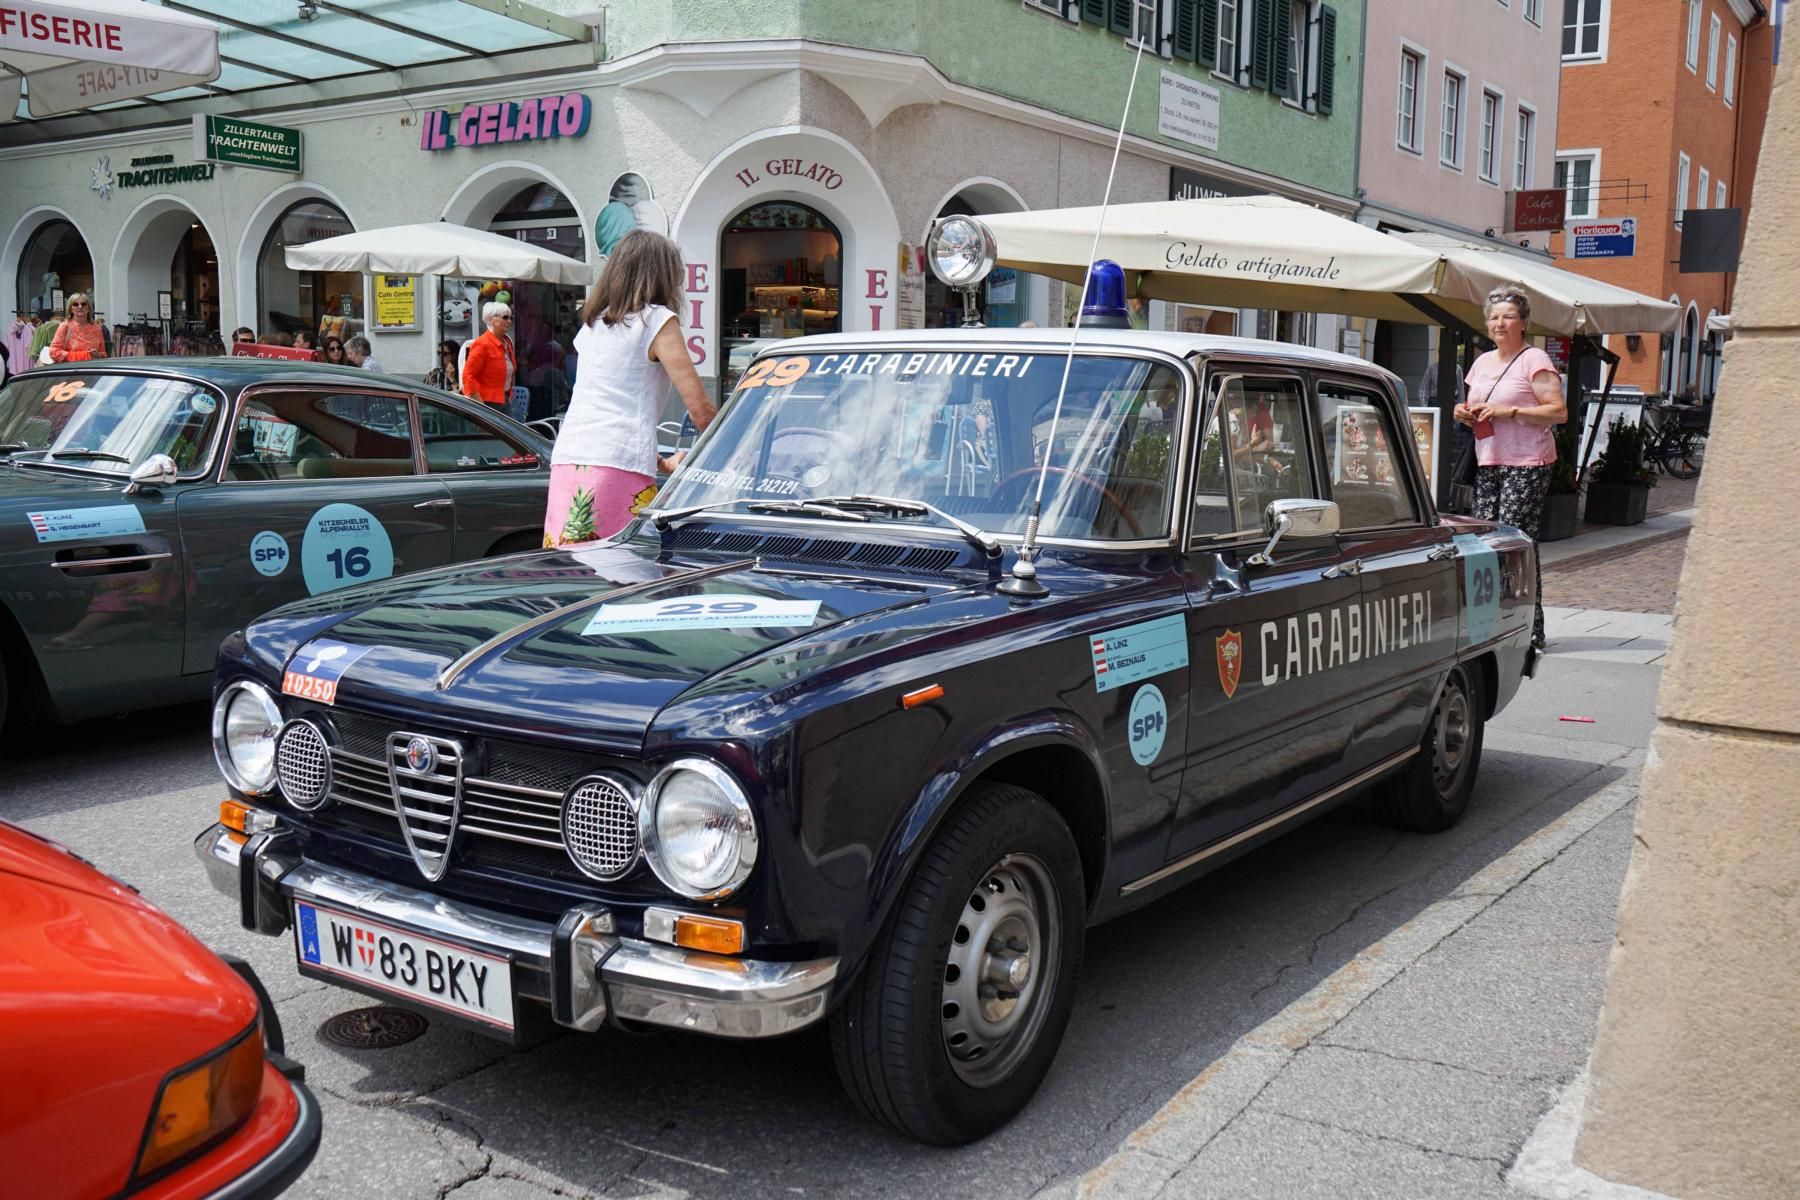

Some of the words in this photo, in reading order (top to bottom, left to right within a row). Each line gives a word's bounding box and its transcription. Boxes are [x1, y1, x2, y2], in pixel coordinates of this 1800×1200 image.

[224, 124, 285, 142] ZILLERTALER
[421, 110, 452, 151] IL
[458, 92, 591, 147] GELATO
[209, 134, 297, 156] TRACHTENWELT
[117, 163, 216, 189] TRACHTENWELT
[736, 168, 760, 188] IL
[765, 159, 843, 190] GELATO
[1576, 225, 1618, 236] Hartlauer
[1165, 241, 1228, 269] Gelato
[1236, 256, 1341, 280] artigianale
[736, 357, 811, 391] 29
[814, 353, 1034, 378] CARABINIERI
[44, 381, 86, 402] 16
[318, 518, 369, 526] KITZBÜHELER
[320, 525, 370, 533] ALPENRALLYE
[326, 546, 371, 579] 16
[1473, 566, 1494, 607] 29
[656, 602, 758, 616] 29
[1106, 644, 1113, 652] A.
[1113, 639, 1129, 650] LINZ
[1260, 590, 1432, 687] CARABINIERI
[1108, 662, 1116, 671] M.
[286, 671, 333, 701] 10250
[308, 942, 317, 955] A
[330, 920, 352, 966] W
[379, 936, 417, 986] 83
[426, 949, 487, 1008] BKY
